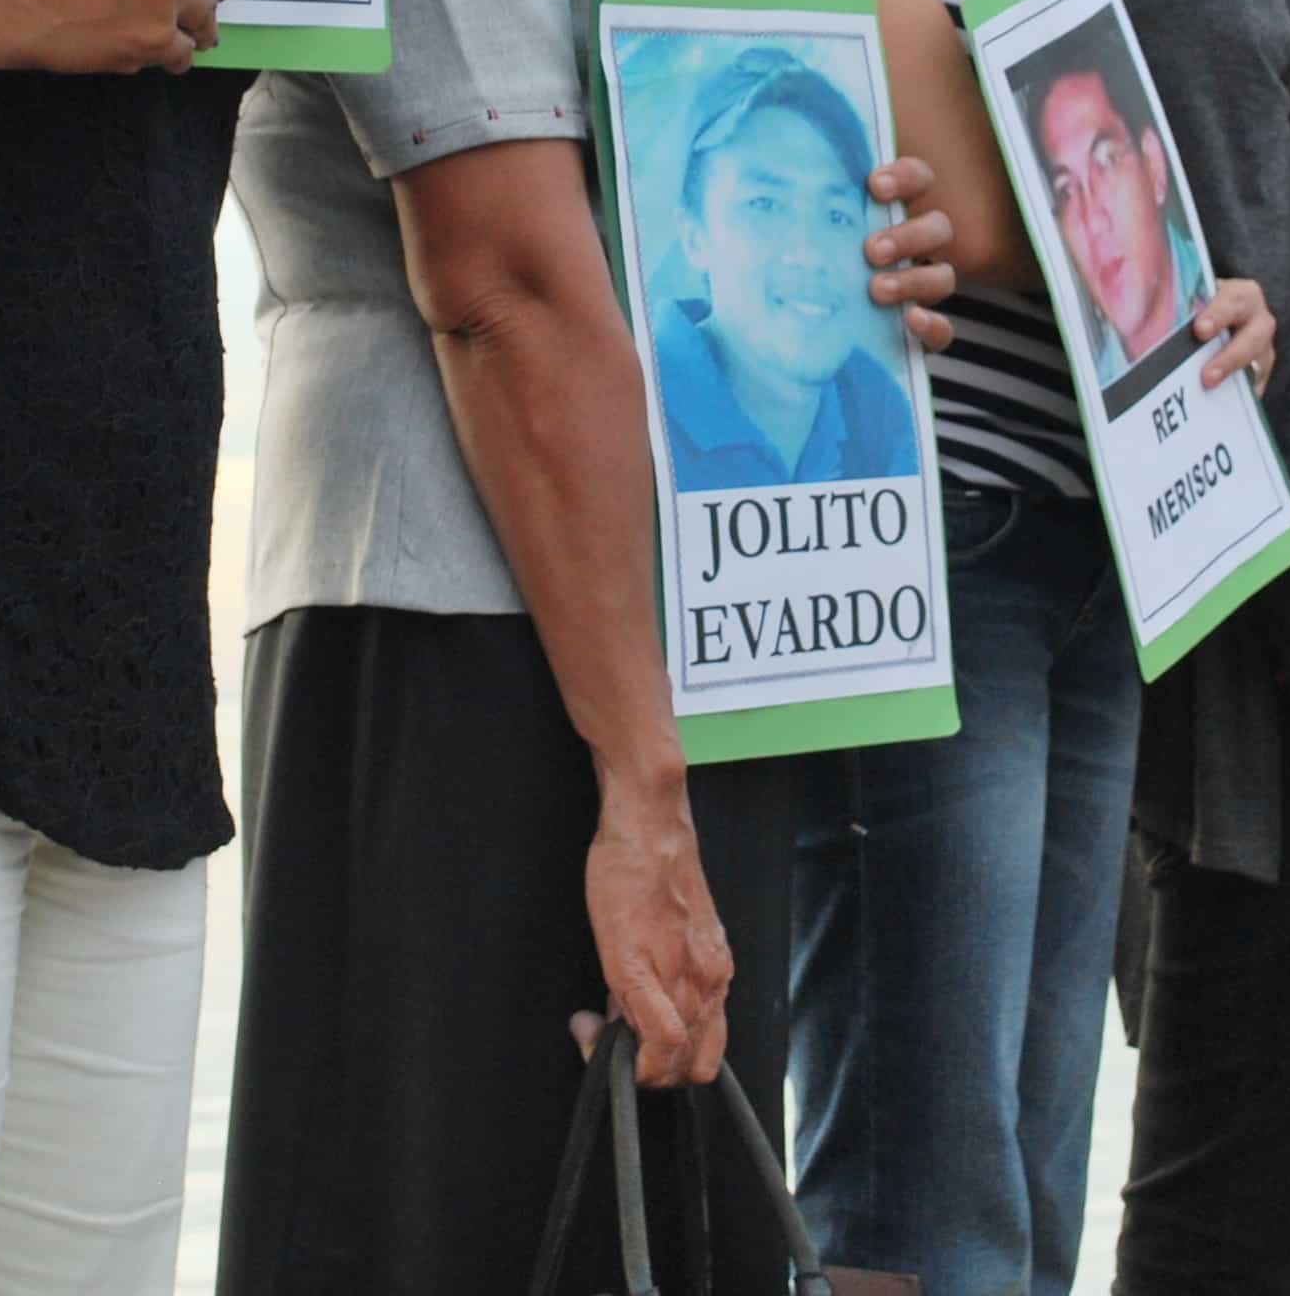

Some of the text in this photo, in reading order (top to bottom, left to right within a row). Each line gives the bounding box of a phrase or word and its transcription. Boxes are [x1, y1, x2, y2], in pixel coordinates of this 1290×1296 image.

[1151, 385, 1189, 444] REY
[701, 488, 908, 583] JOLITO
[1147, 443, 1233, 540] MERISCO
[687, 584, 927, 666] EVARDO
